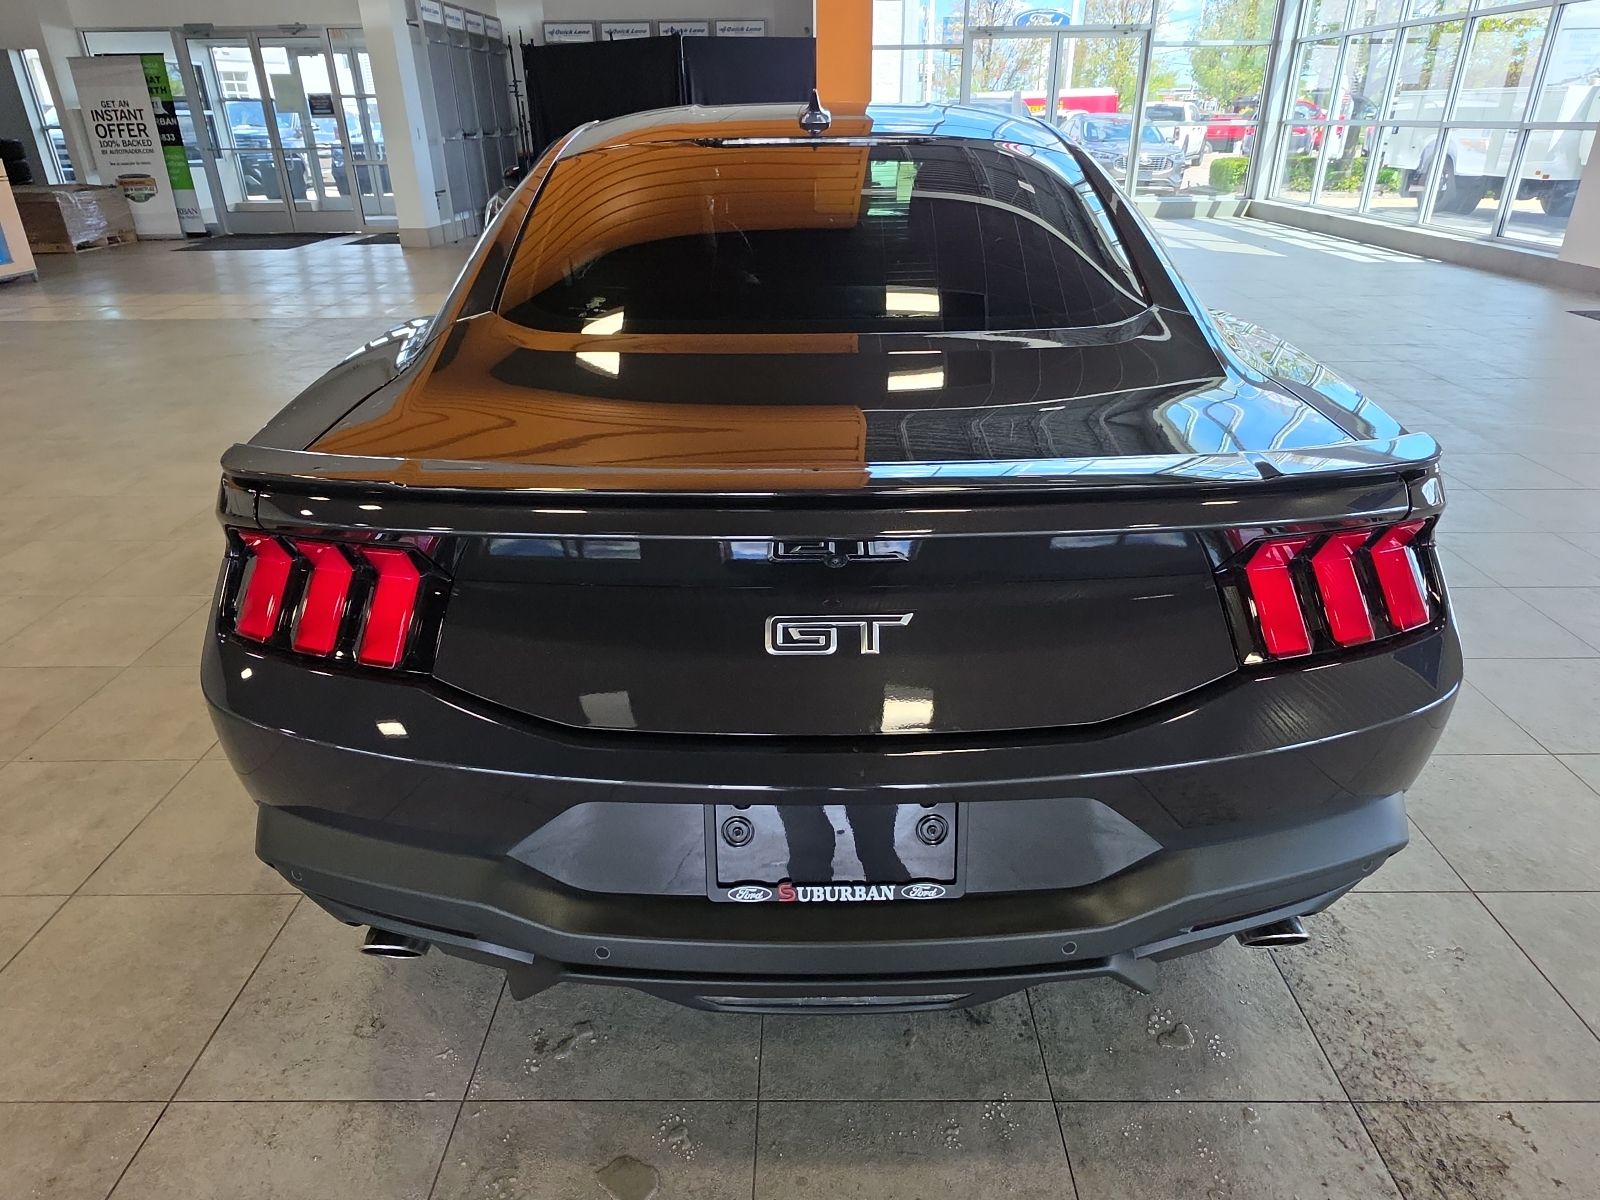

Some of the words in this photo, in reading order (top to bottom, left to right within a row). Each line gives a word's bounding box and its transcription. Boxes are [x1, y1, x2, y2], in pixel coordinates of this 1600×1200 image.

[91, 108, 144, 122] INSTANT
[95, 123, 150, 139] OFFER
[99, 140, 120, 148] 100%
[765, 612, 914, 655] GT
[778, 882, 896, 904] SUBURBAN
